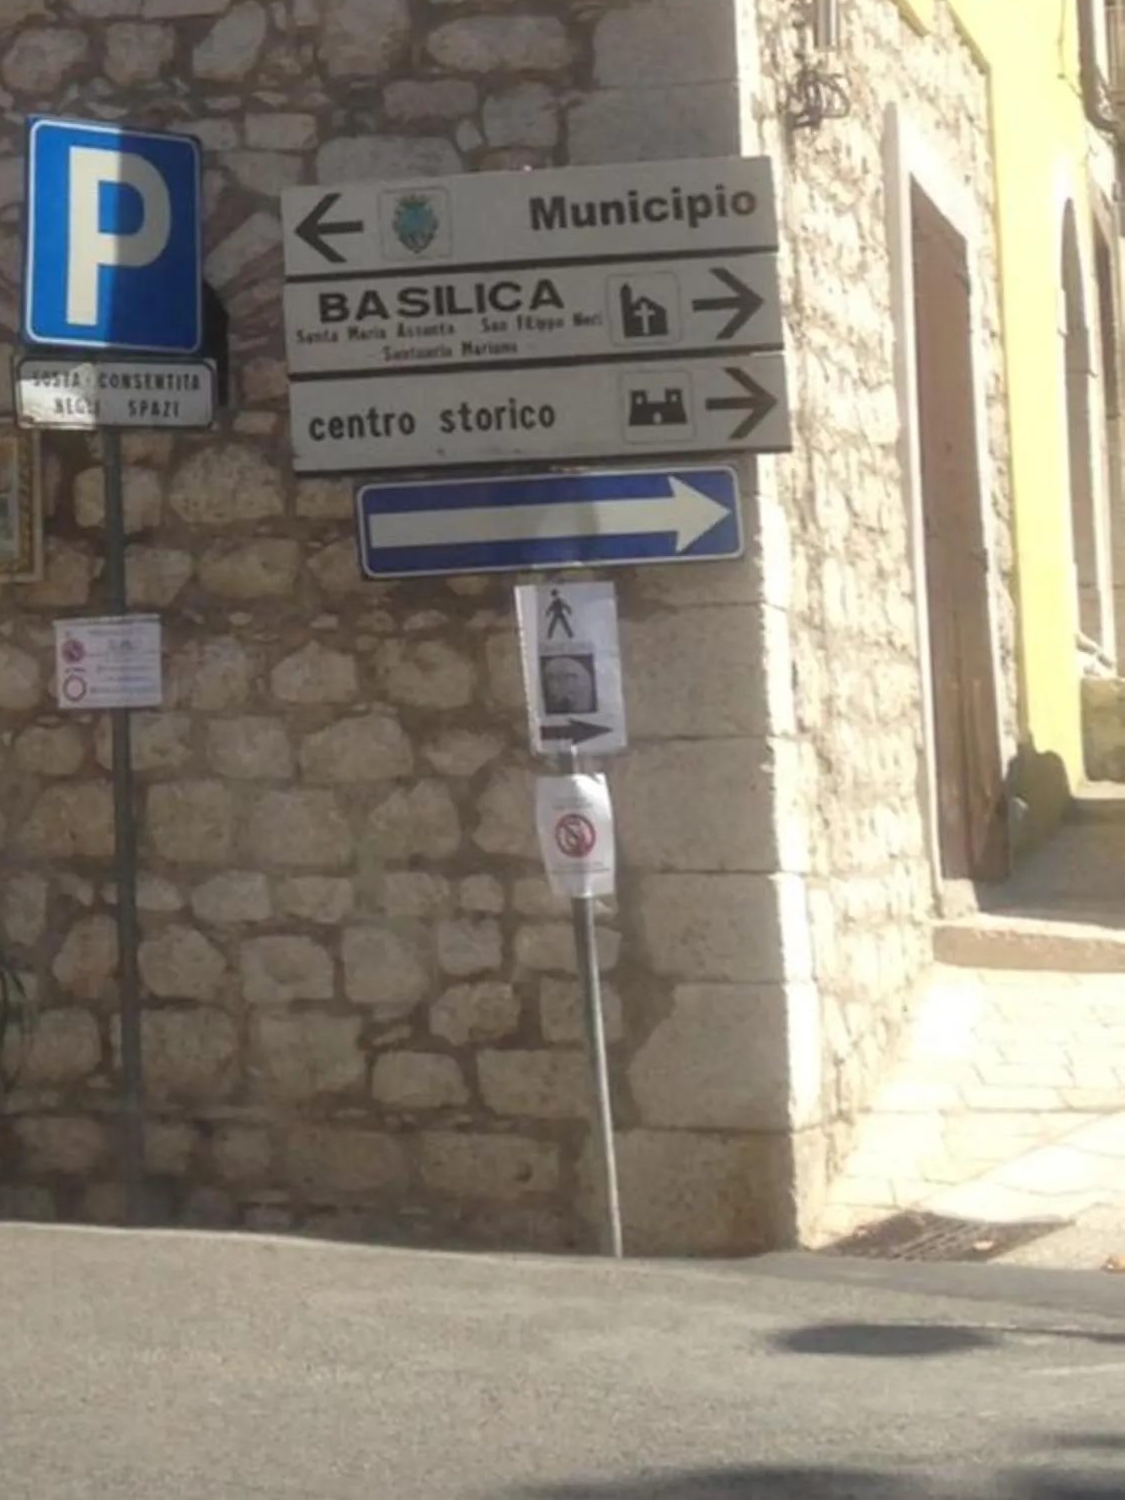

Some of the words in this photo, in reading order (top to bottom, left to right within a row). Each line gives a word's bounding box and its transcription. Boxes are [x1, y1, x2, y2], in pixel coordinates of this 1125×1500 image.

[528, 185, 758, 231] Municipio
[66, 145, 172, 327] P
[319, 279, 565, 324] BASILICA
[295, 328, 339, 344] Santa
[346, 325, 387, 341] Maria
[480, 316, 509, 333] San
[32, 370, 82, 389] SOSTA
[97, 371, 202, 392] CONSENTITA
[127, 399, 182, 419] SPAZI
[307, 405, 417, 443] centro
[438, 397, 557, 435] storico
